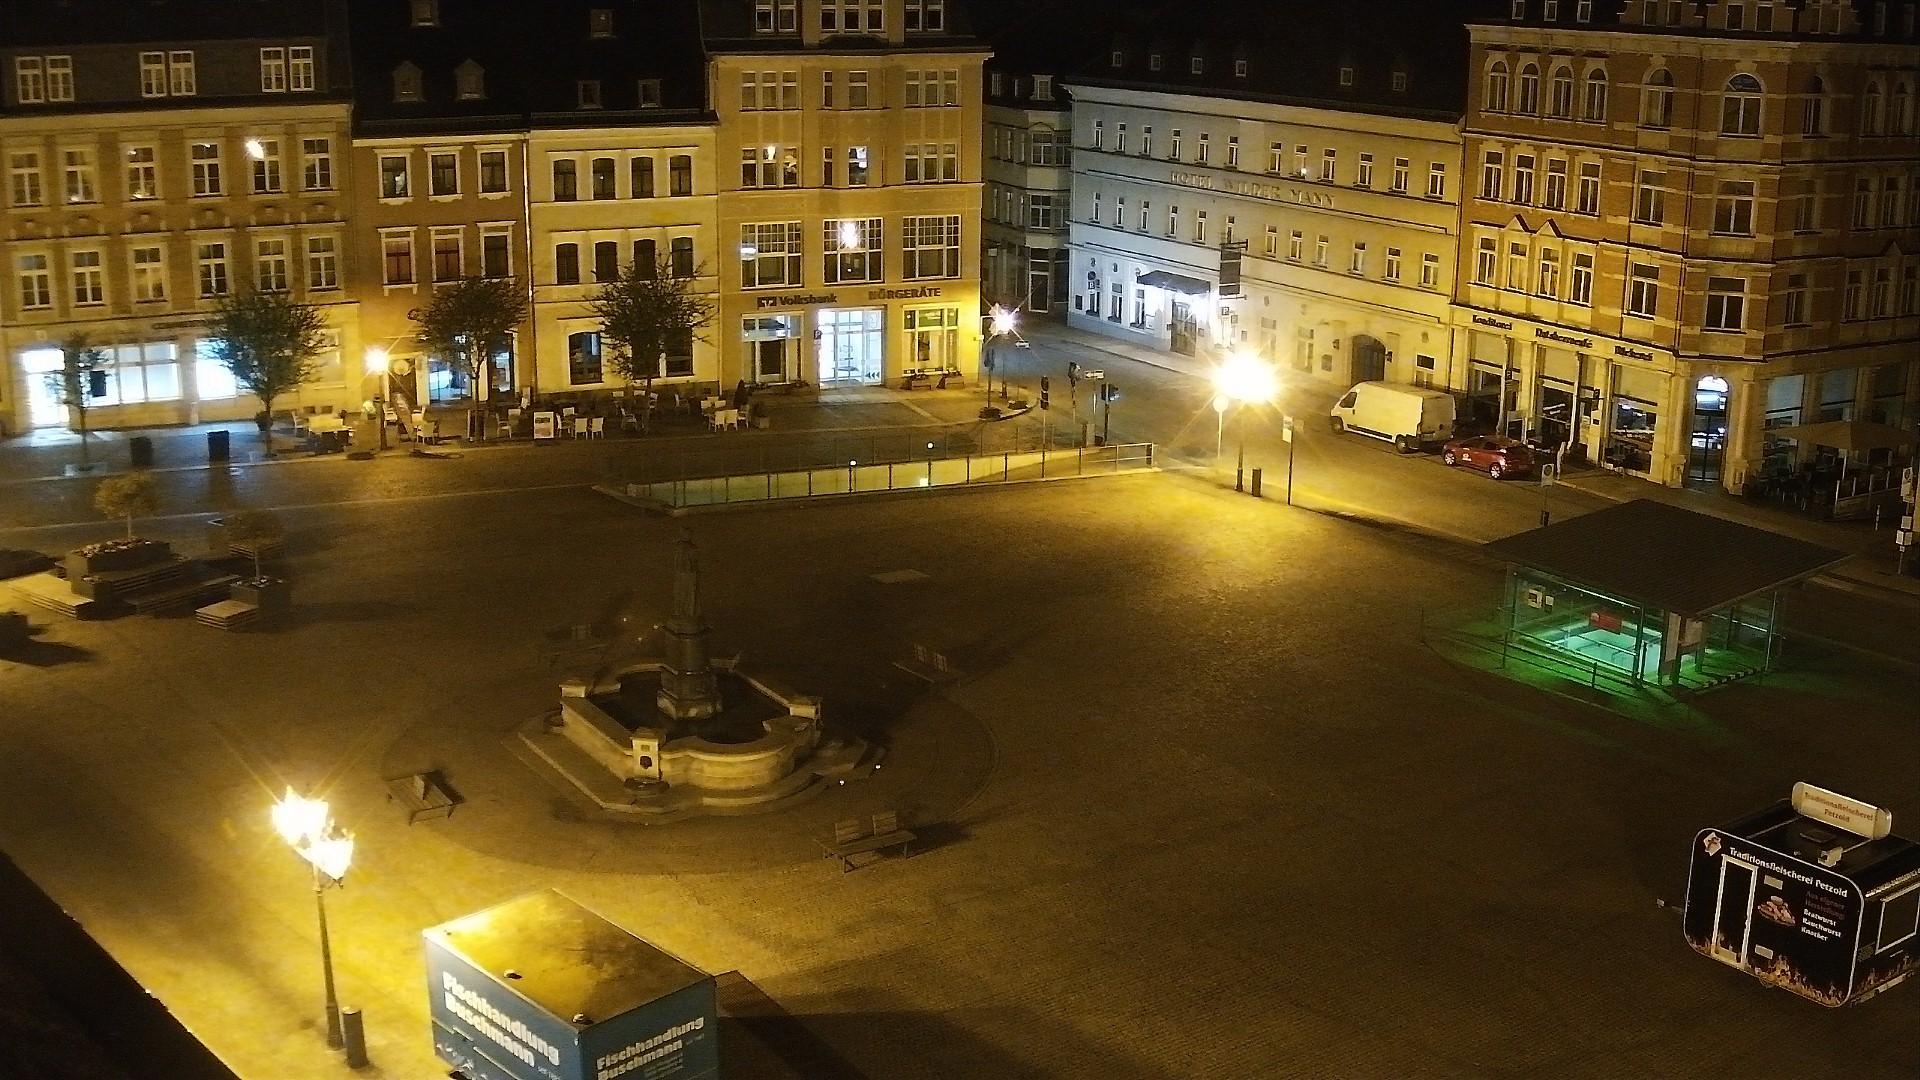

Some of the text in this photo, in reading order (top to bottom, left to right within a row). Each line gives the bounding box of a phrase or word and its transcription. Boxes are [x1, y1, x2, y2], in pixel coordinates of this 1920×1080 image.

[1171, 171, 1335, 209] HOTEL WILDER MANN
[779, 293, 838, 306] Volksbank
[868, 286, 941, 300] HÖRGERÄTE
[1804, 791, 1874, 822] Traditionsfleischerei
[1824, 808, 1850, 823] Petzold
[1729, 846, 1814, 886] Traditionsfleischerei
[1815, 877, 1848, 898] Petzold
[1802, 917, 1842, 938] Rauchwurst
[1803, 908, 1837, 927] Bratwurst
[443, 971, 560, 1066] Fischhandlung
[445, 991, 535, 1068] Buschmann
[596, 1016, 704, 1070] Fischhandlung
[597, 1039, 683, 1080] Buschmann
